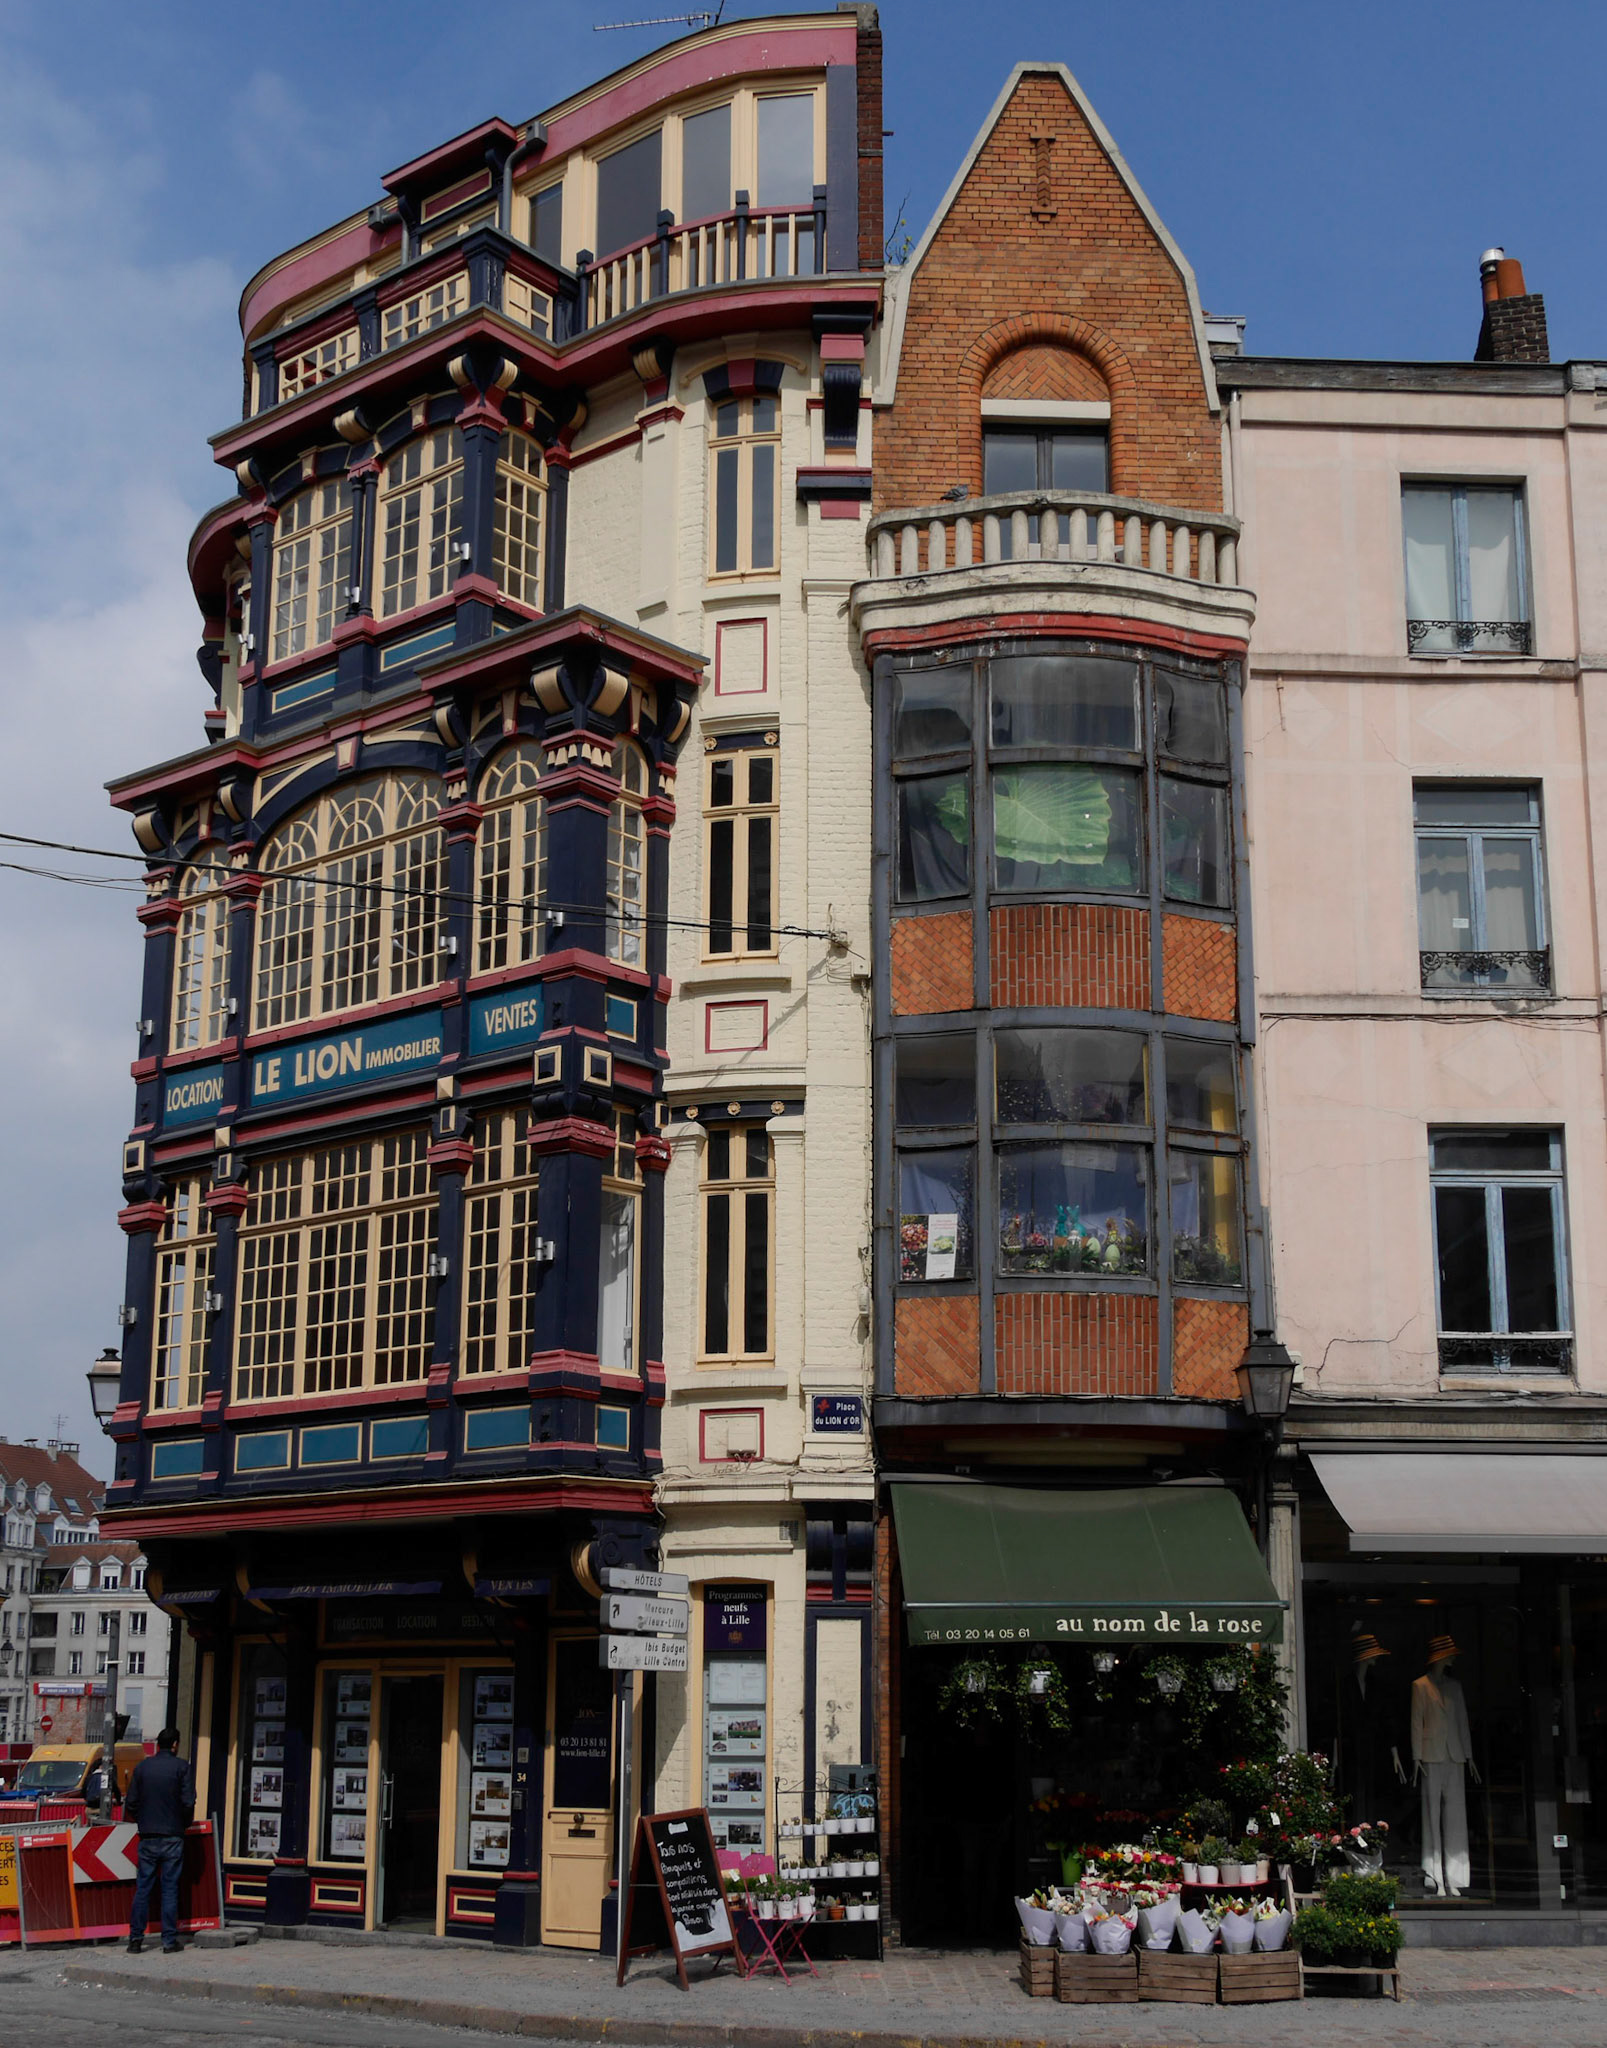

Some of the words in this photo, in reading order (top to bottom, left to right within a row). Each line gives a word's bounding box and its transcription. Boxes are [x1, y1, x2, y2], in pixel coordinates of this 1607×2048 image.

[484, 998, 537, 1036] VENTES
[254, 1057, 282, 1096] LE
[294, 1036, 364, 1087] LION
[365, 1036, 442, 1070] IMMOBILIER
[836, 1402, 856, 1411] Place
[815, 1416, 824, 1425] du
[825, 1416, 842, 1425] LION
[843, 1416, 860, 1425] d'OR
[634, 1573, 663, 1587] HÔTELS
[709, 1591, 763, 1601] Programmes
[723, 1602, 748, 1612] neufs
[721, 1615, 727, 1625] à
[729, 1615, 750, 1625] Lille
[1056, 1618, 1084, 1632] au
[1092, 1618, 1146, 1632] nom
[1154, 1610, 1181, 1632] de
[1189, 1611, 1209, 1632] la
[1217, 1618, 1263, 1633] rose
[946, 1629, 961, 1640] 03
[965, 1629, 980, 1639] 20
[984, 1629, 995, 1639] 14
[999, 1629, 1014, 1639] 05
[1018, 1628, 1030, 1638] 61
[645, 1642, 658, 1652] Ibis
[661, 1643, 685, 1655] Budget
[644, 1657, 660, 1666] Lille
[560, 1736, 569, 1747] 03
[570, 1736, 579, 1747] 20
[580, 1736, 588, 1747] 13
[516, 1772, 527, 1783] 34
